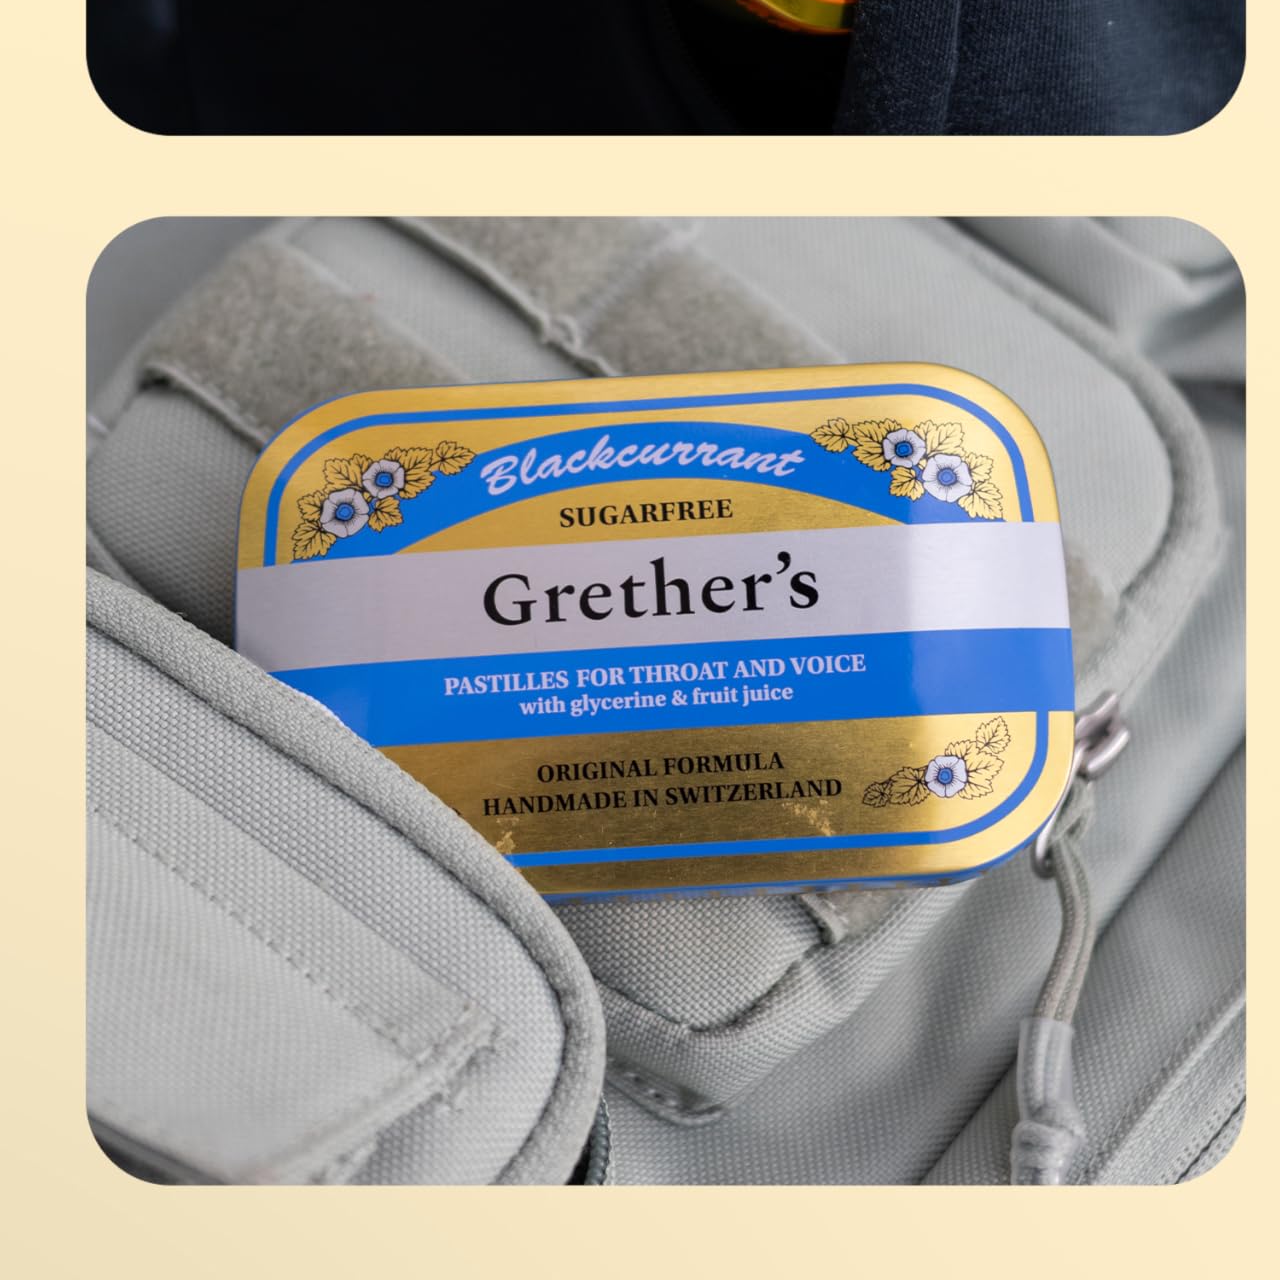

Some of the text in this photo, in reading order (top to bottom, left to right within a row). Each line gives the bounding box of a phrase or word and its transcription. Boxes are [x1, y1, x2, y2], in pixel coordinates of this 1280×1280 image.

[480, 435, 805, 495] Blackcurrant
[559, 499, 733, 528] SUGARFREE
[444, 654, 867, 696] PASTILLES FOR THROAT AND VOICE
[519, 684, 794, 717] with glycerine & fruit juice
[537, 752, 784, 783] ORIGINAL FORMULA
[483, 778, 842, 816] HANDMADE IN SWITZERLAND
